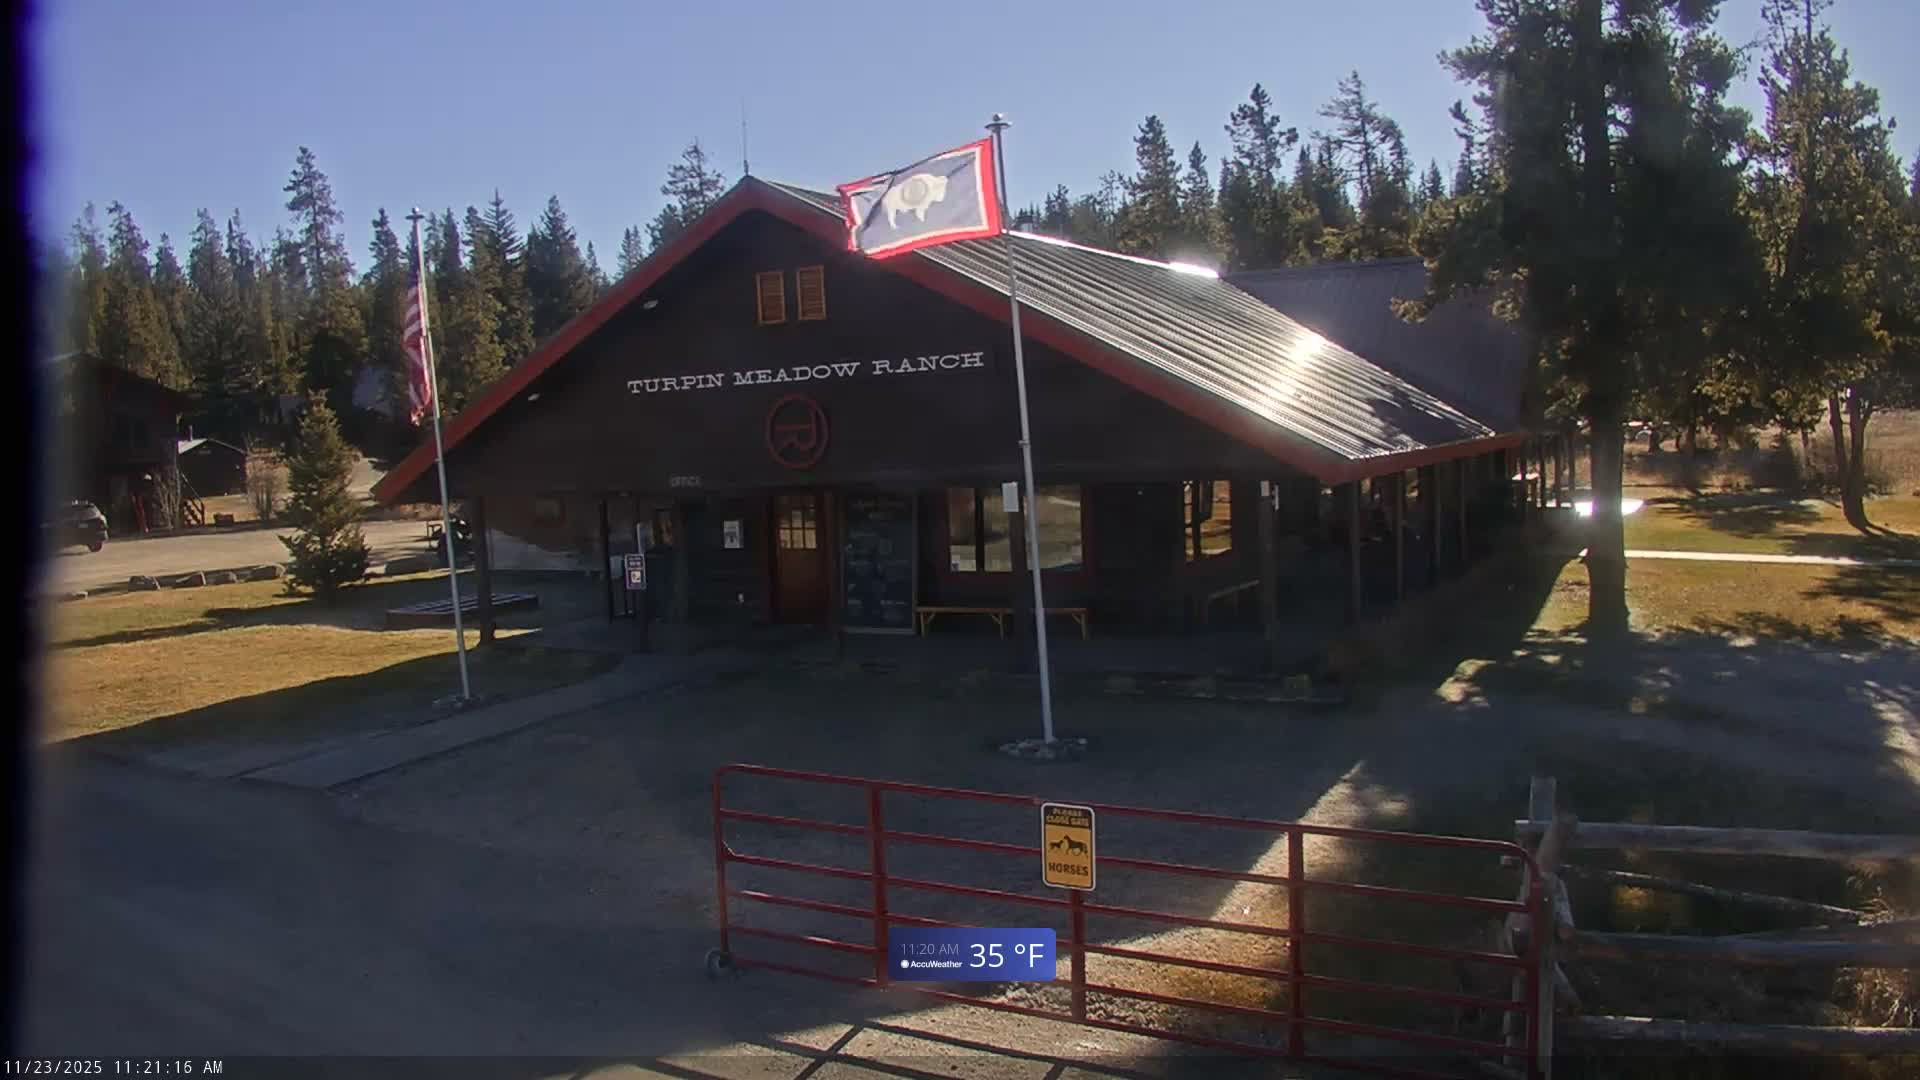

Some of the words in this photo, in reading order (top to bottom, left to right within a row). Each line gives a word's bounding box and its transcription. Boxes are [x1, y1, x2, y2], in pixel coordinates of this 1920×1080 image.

[627, 373, 725, 394] TURPIN
[733, 362, 861, 386] MEADOW
[872, 352, 985, 375] RANCH
[1048, 862, 1089, 877] HORSES
